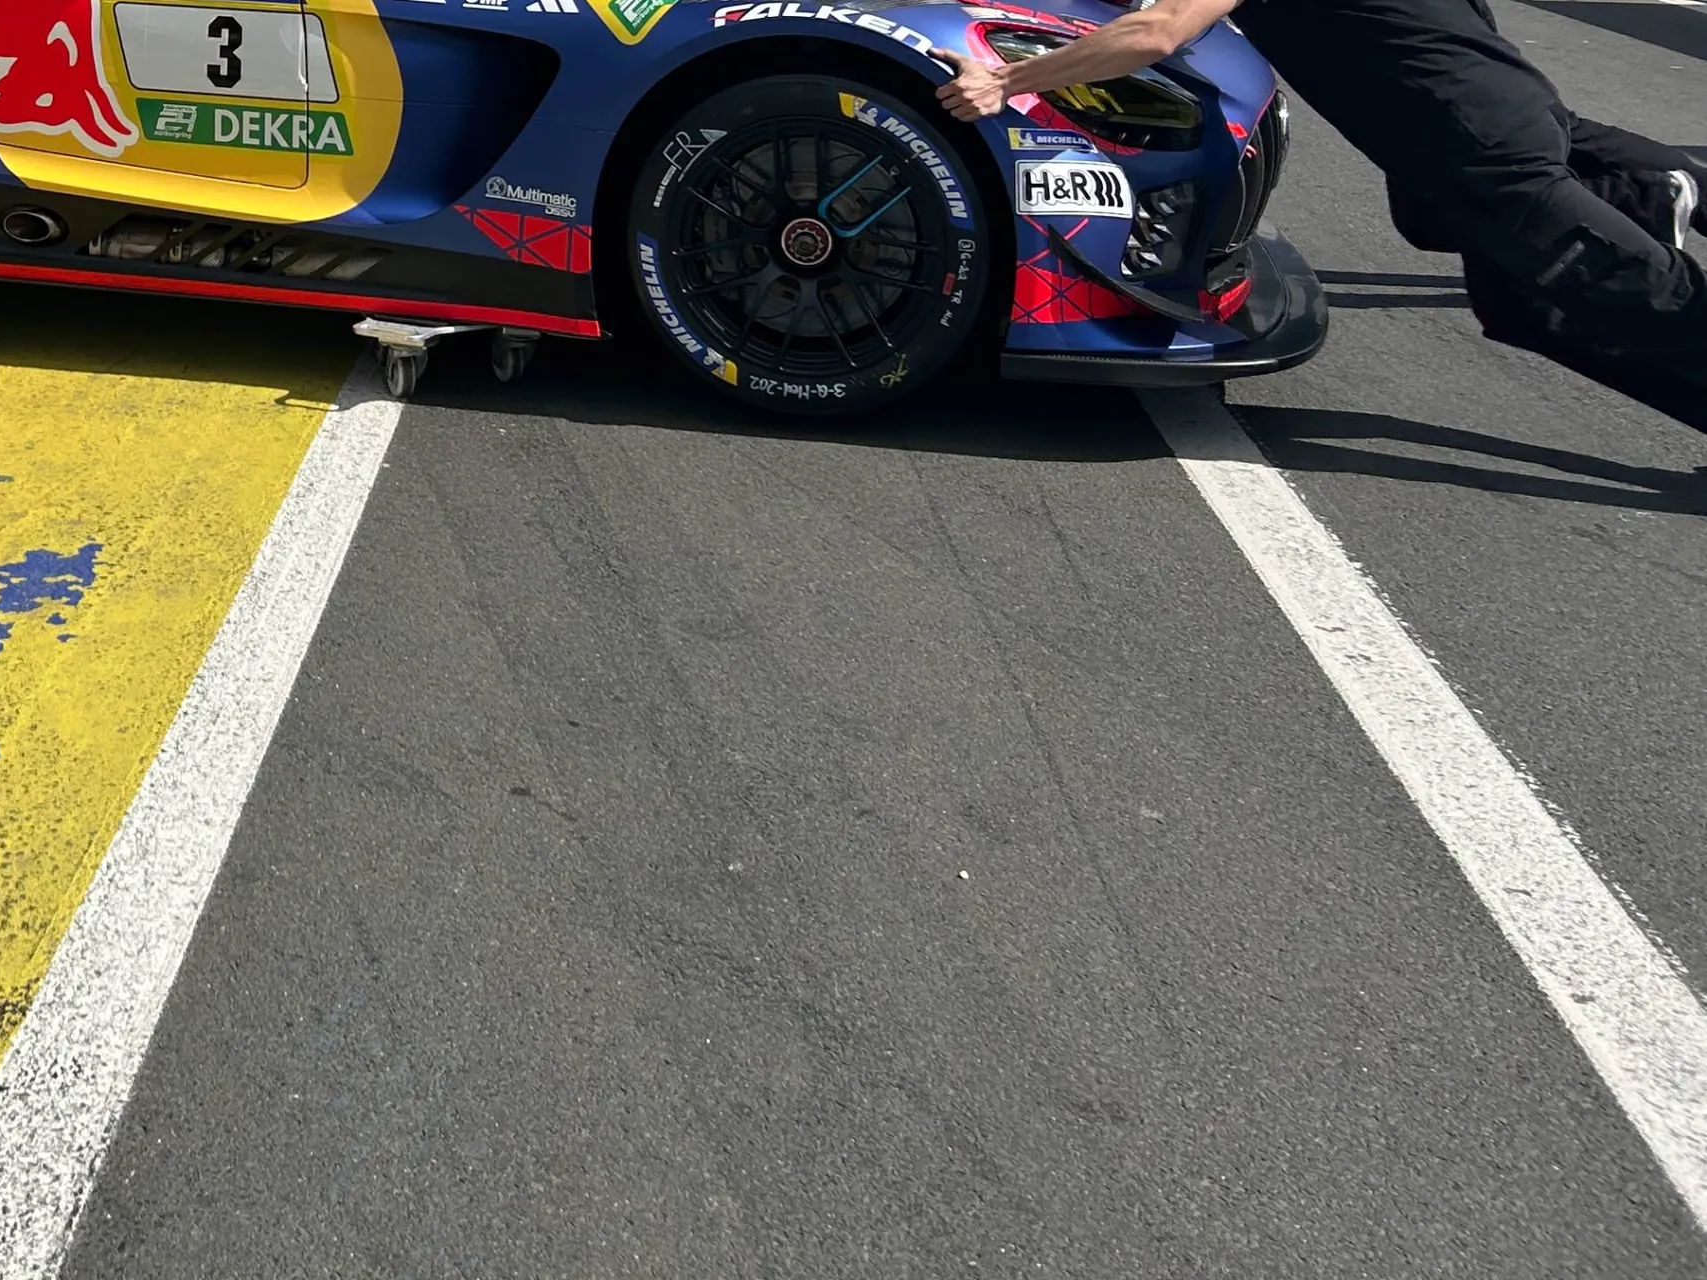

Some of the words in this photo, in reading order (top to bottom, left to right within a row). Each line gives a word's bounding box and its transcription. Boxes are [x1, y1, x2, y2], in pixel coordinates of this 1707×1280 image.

[206, 15, 243, 88] 3
[713, 1, 936, 57] FALKEN
[214, 108, 347, 152] DEKRA
[1036, 134, 1090, 147] MICHELIN
[880, 116, 968, 219] MICHELIN
[1025, 170, 1092, 202] H&R
[506, 184, 577, 208] Multimatic
[639, 243, 704, 354] MICHELIN
